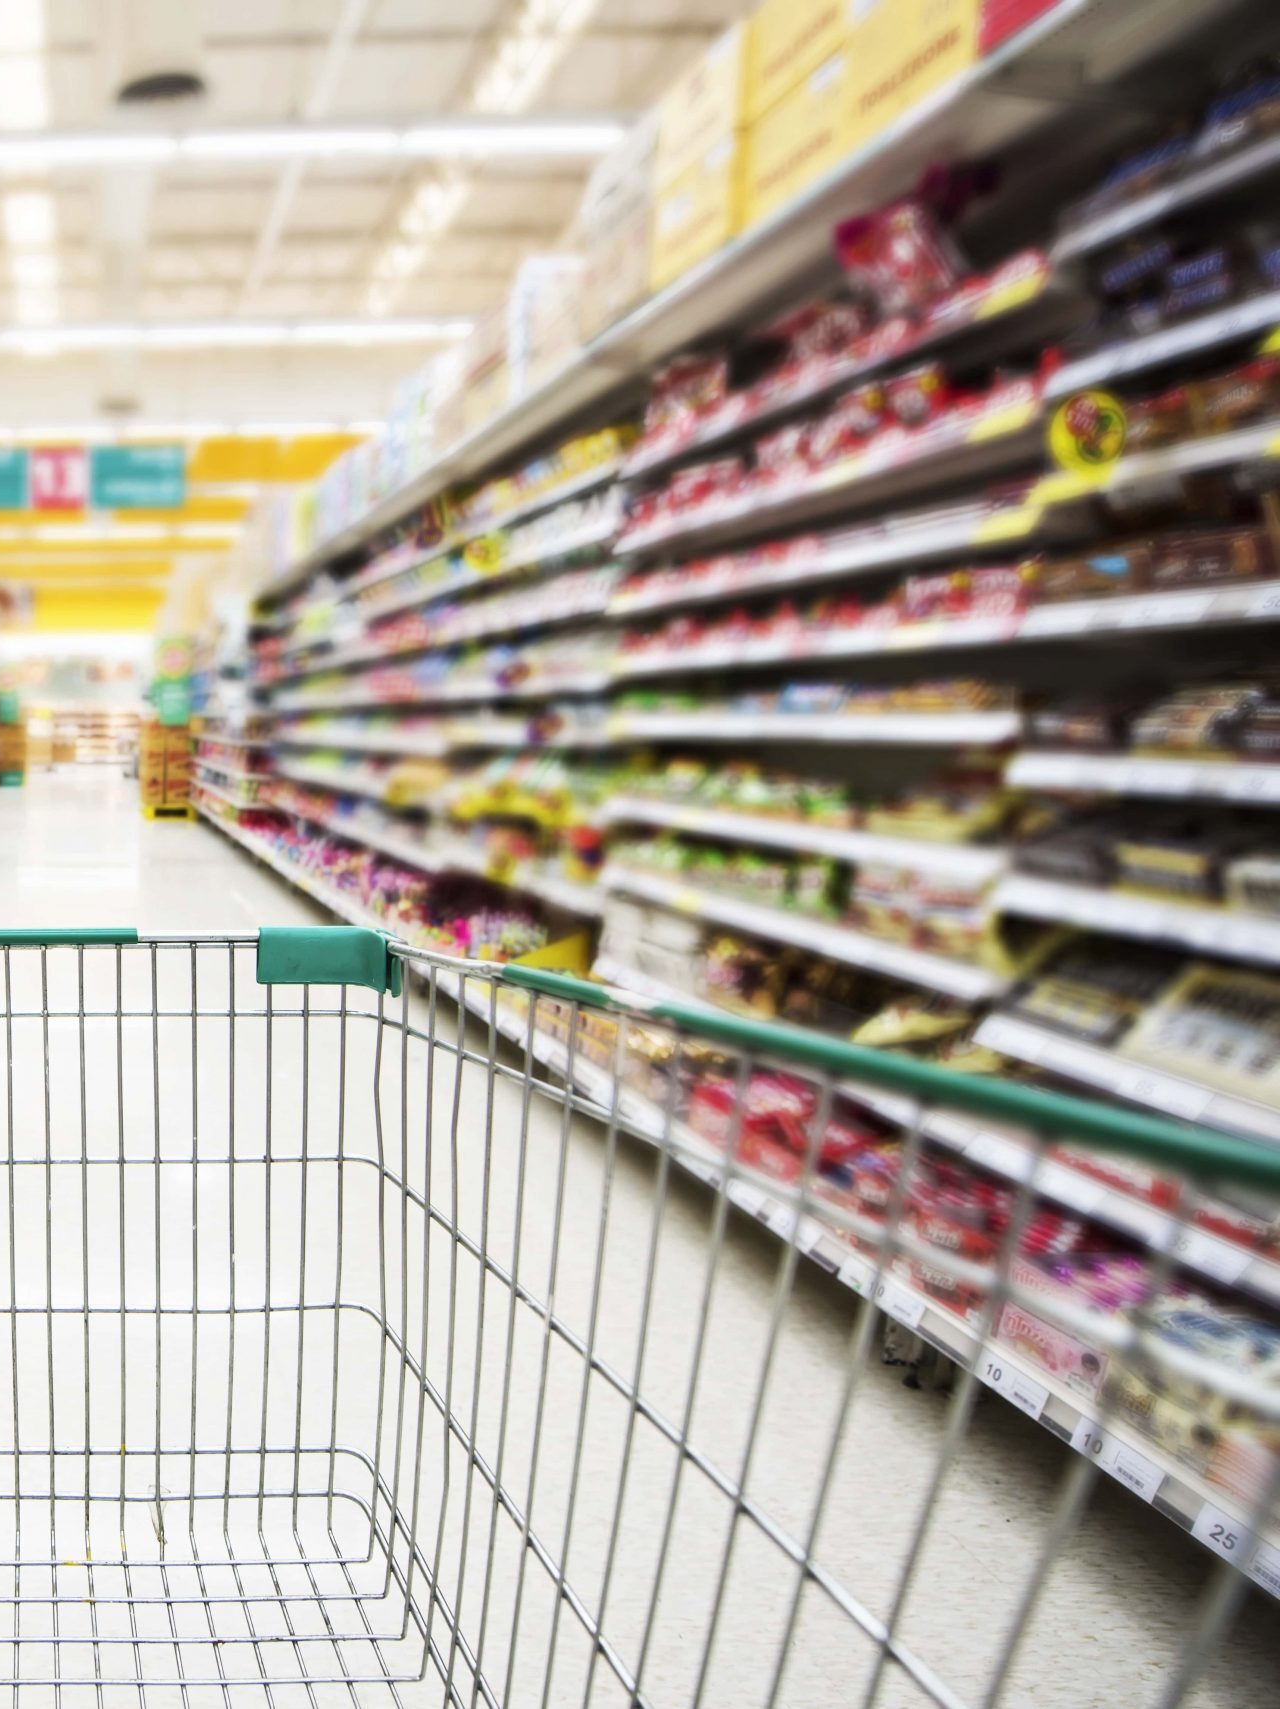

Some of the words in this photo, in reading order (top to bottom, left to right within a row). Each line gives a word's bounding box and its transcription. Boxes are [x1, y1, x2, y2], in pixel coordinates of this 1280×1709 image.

[986, 1363, 1002, 1382] 10
[1084, 1433, 1103, 1454] 10
[1209, 1524, 1238, 1550] 25
